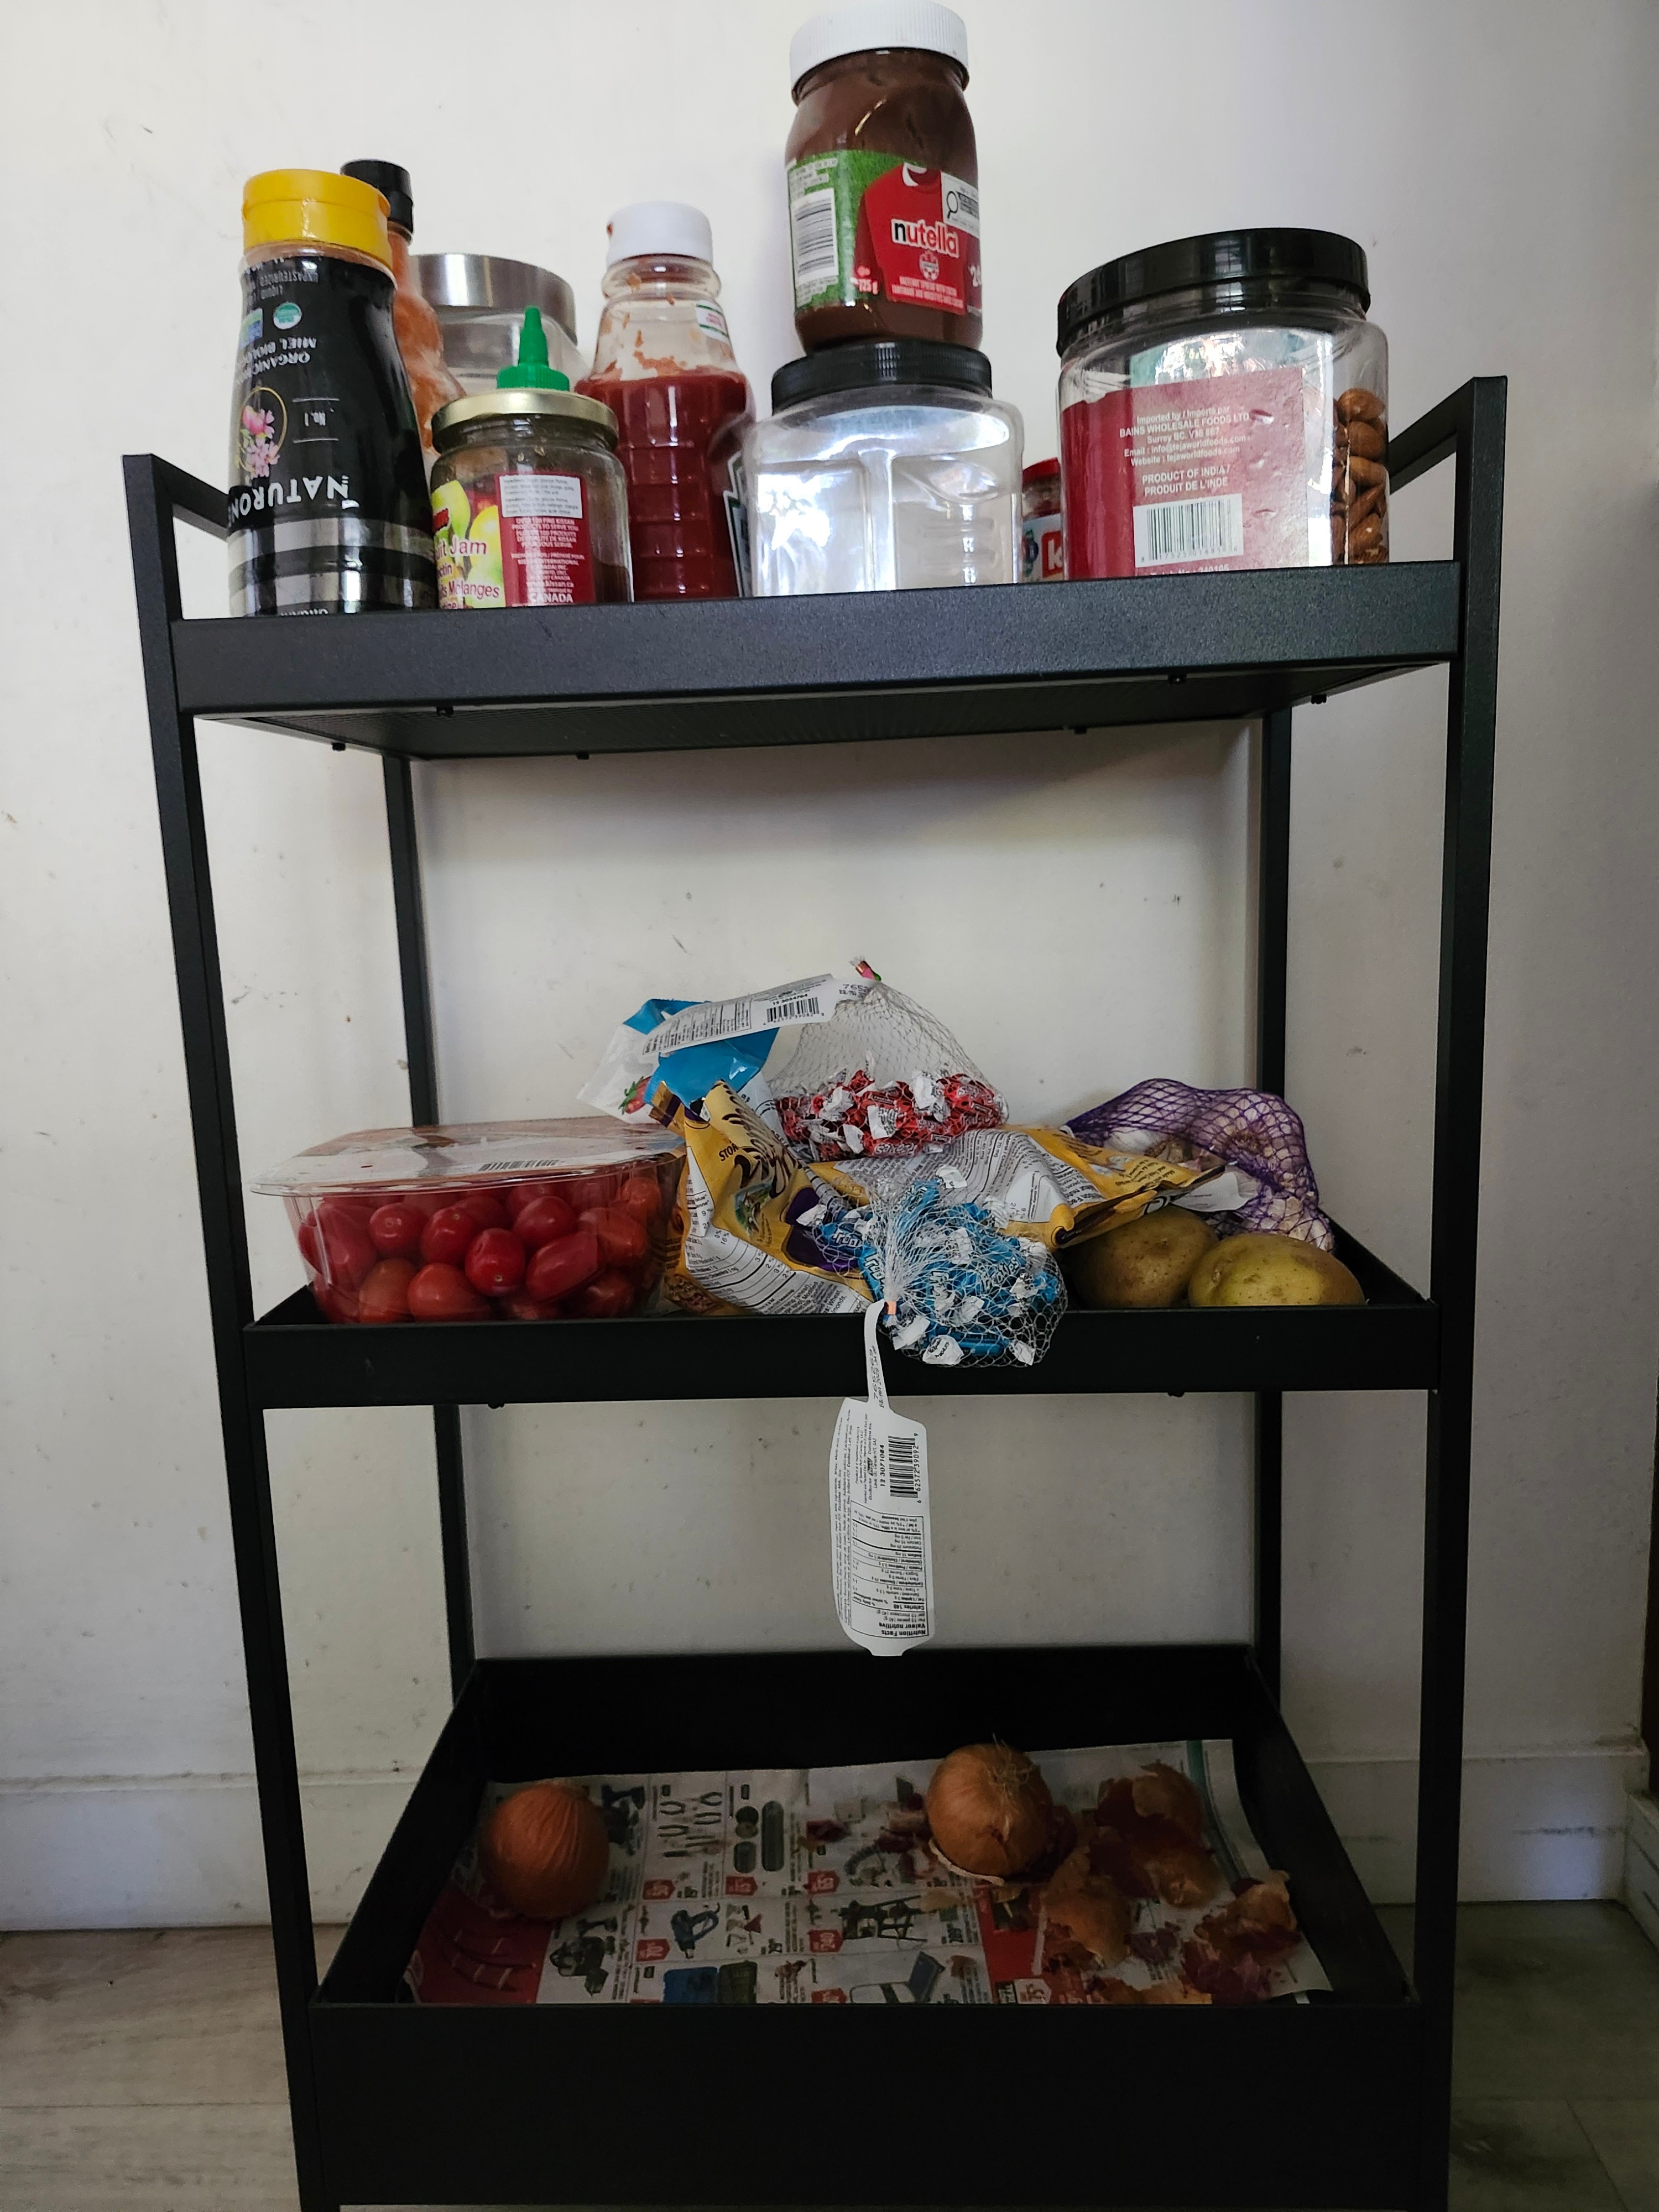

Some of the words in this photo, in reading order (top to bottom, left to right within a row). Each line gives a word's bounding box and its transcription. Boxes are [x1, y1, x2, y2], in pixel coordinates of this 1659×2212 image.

[894, 222, 957, 254] nutella
[1137, 411, 1170, 424] Imported
[1172, 411, 1181, 421] by
[1218, 406, 1230, 416] par
[1119, 426, 1145, 438] BAINS
[1147, 419, 1199, 434] WHOLESALE
[1202, 415, 1232, 426] FOODS
[1124, 447, 1145, 457] Email
[1151, 435, 1246, 454] info@tejaworldfoods.com
[1147, 435, 1172, 445] Surrey
[1131, 455, 1160, 467] Website
[1167, 446, 1240, 462] tejaworldfoods.com
[1142, 470, 1185, 485] PRODUCT
[1187, 468, 1199, 478] OF
[1201, 466, 1225, 476] INDIA
[1145, 482, 1183, 497] PRODUIT
[1186, 481, 1198, 491] DE
[1200, 477, 1229, 489] L'INDE
[450, 537, 487, 555] Jam
[529, 593, 573, 603] CANADA
